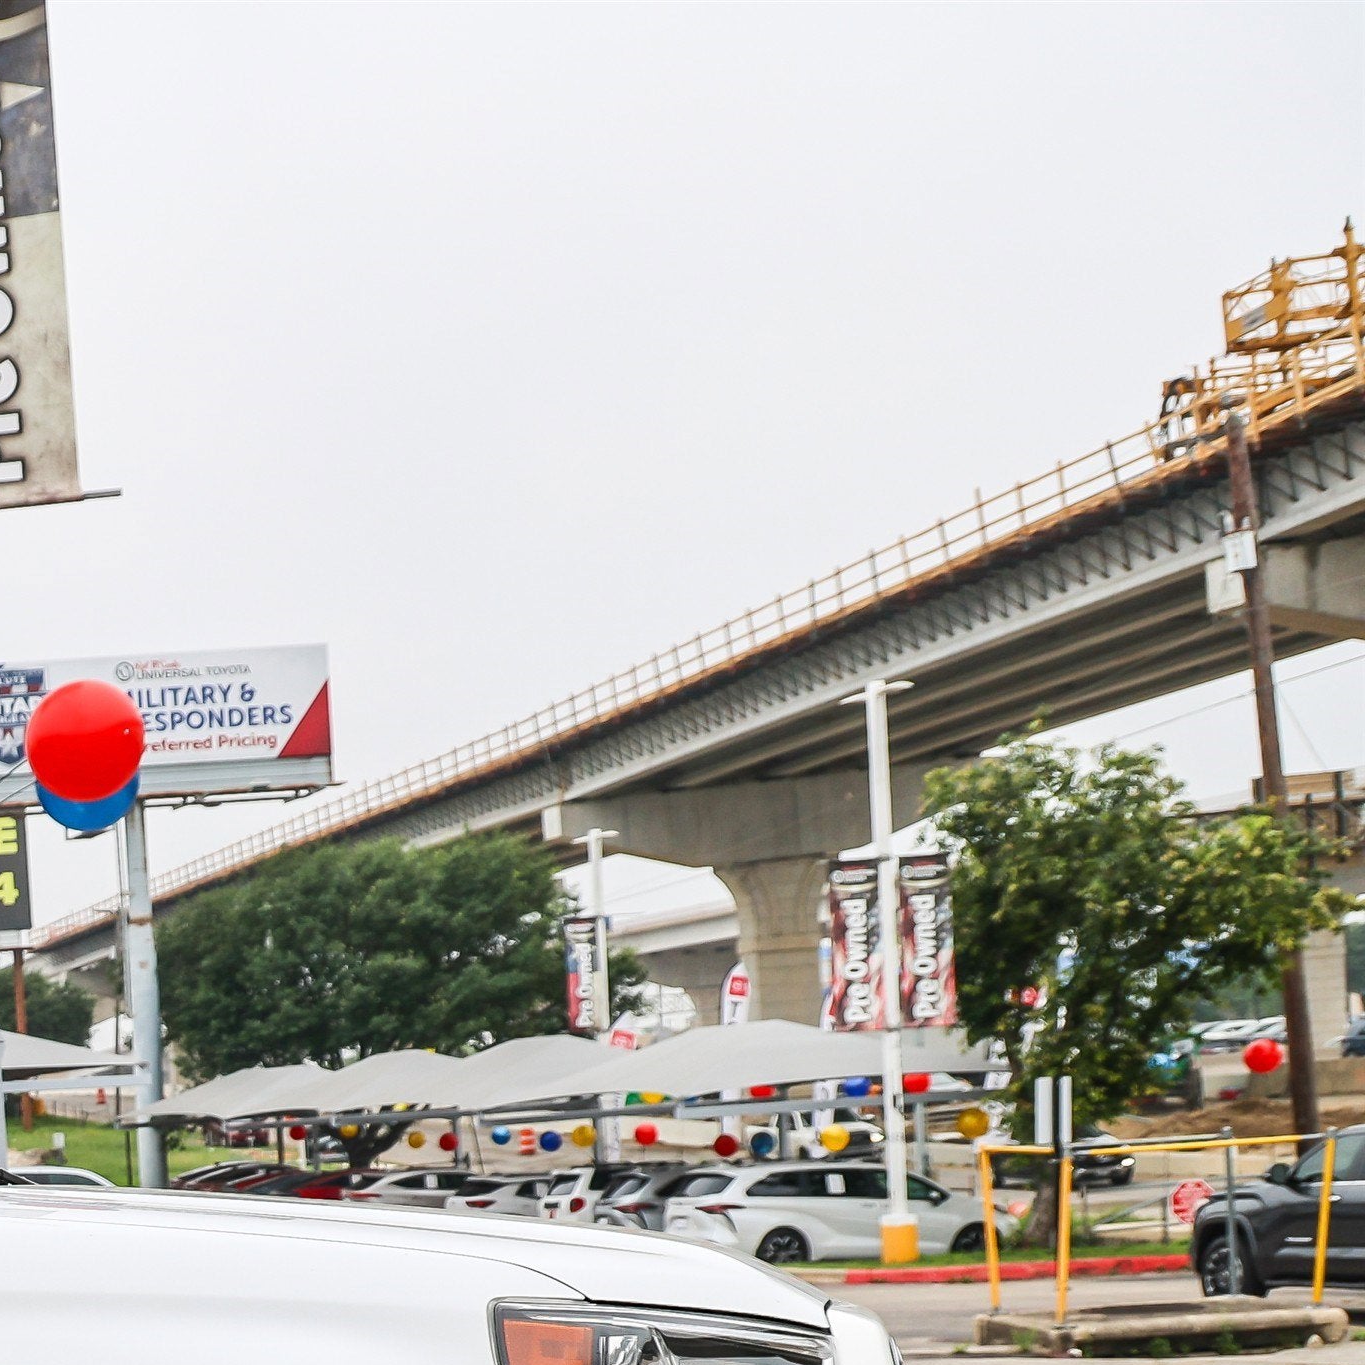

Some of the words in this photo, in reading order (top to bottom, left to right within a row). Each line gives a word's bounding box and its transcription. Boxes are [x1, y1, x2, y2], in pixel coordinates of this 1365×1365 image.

[128, 683, 231, 708] ILITARY
[240, 682, 255, 702] &
[142, 704, 293, 732] ESPONDERS
[144, 735, 213, 752] referred
[844, 982, 872, 1024] Pre
[912, 978, 942, 1020] Pre
